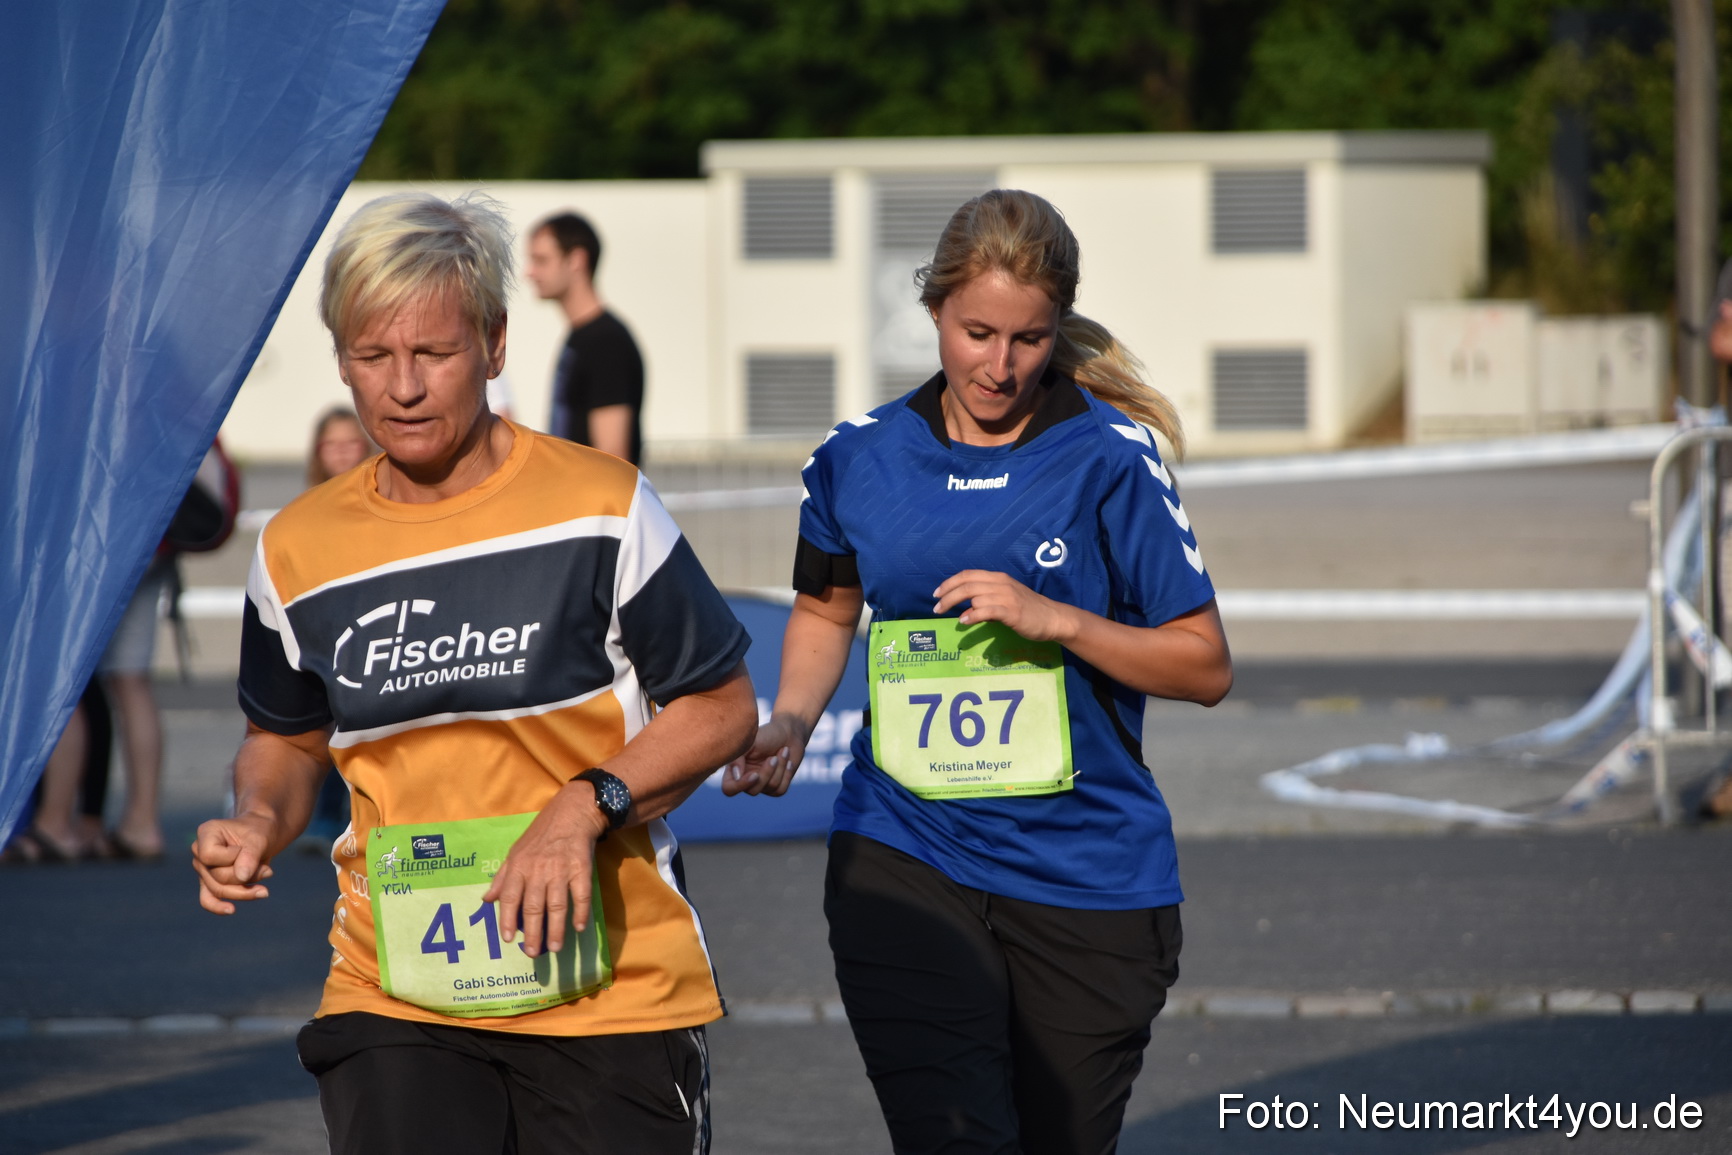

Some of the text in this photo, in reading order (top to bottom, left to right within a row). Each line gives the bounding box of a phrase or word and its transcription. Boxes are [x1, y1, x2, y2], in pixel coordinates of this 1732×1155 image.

[947, 472, 1009, 491] hummel
[363, 622, 541, 676] Fischer
[897, 649, 962, 663] firmenlauf
[379, 658, 527, 695] AUTOMOBILE
[909, 689, 1025, 748] 767
[929, 760, 1012, 772] Kristina Meyer
[946, 775, 981, 783] Lebenshilfe
[401, 852, 477, 872] firmenlauf
[453, 971, 538, 990] Gabi Schmid
[453, 988, 542, 1002] Fischer Automobile GmbH
